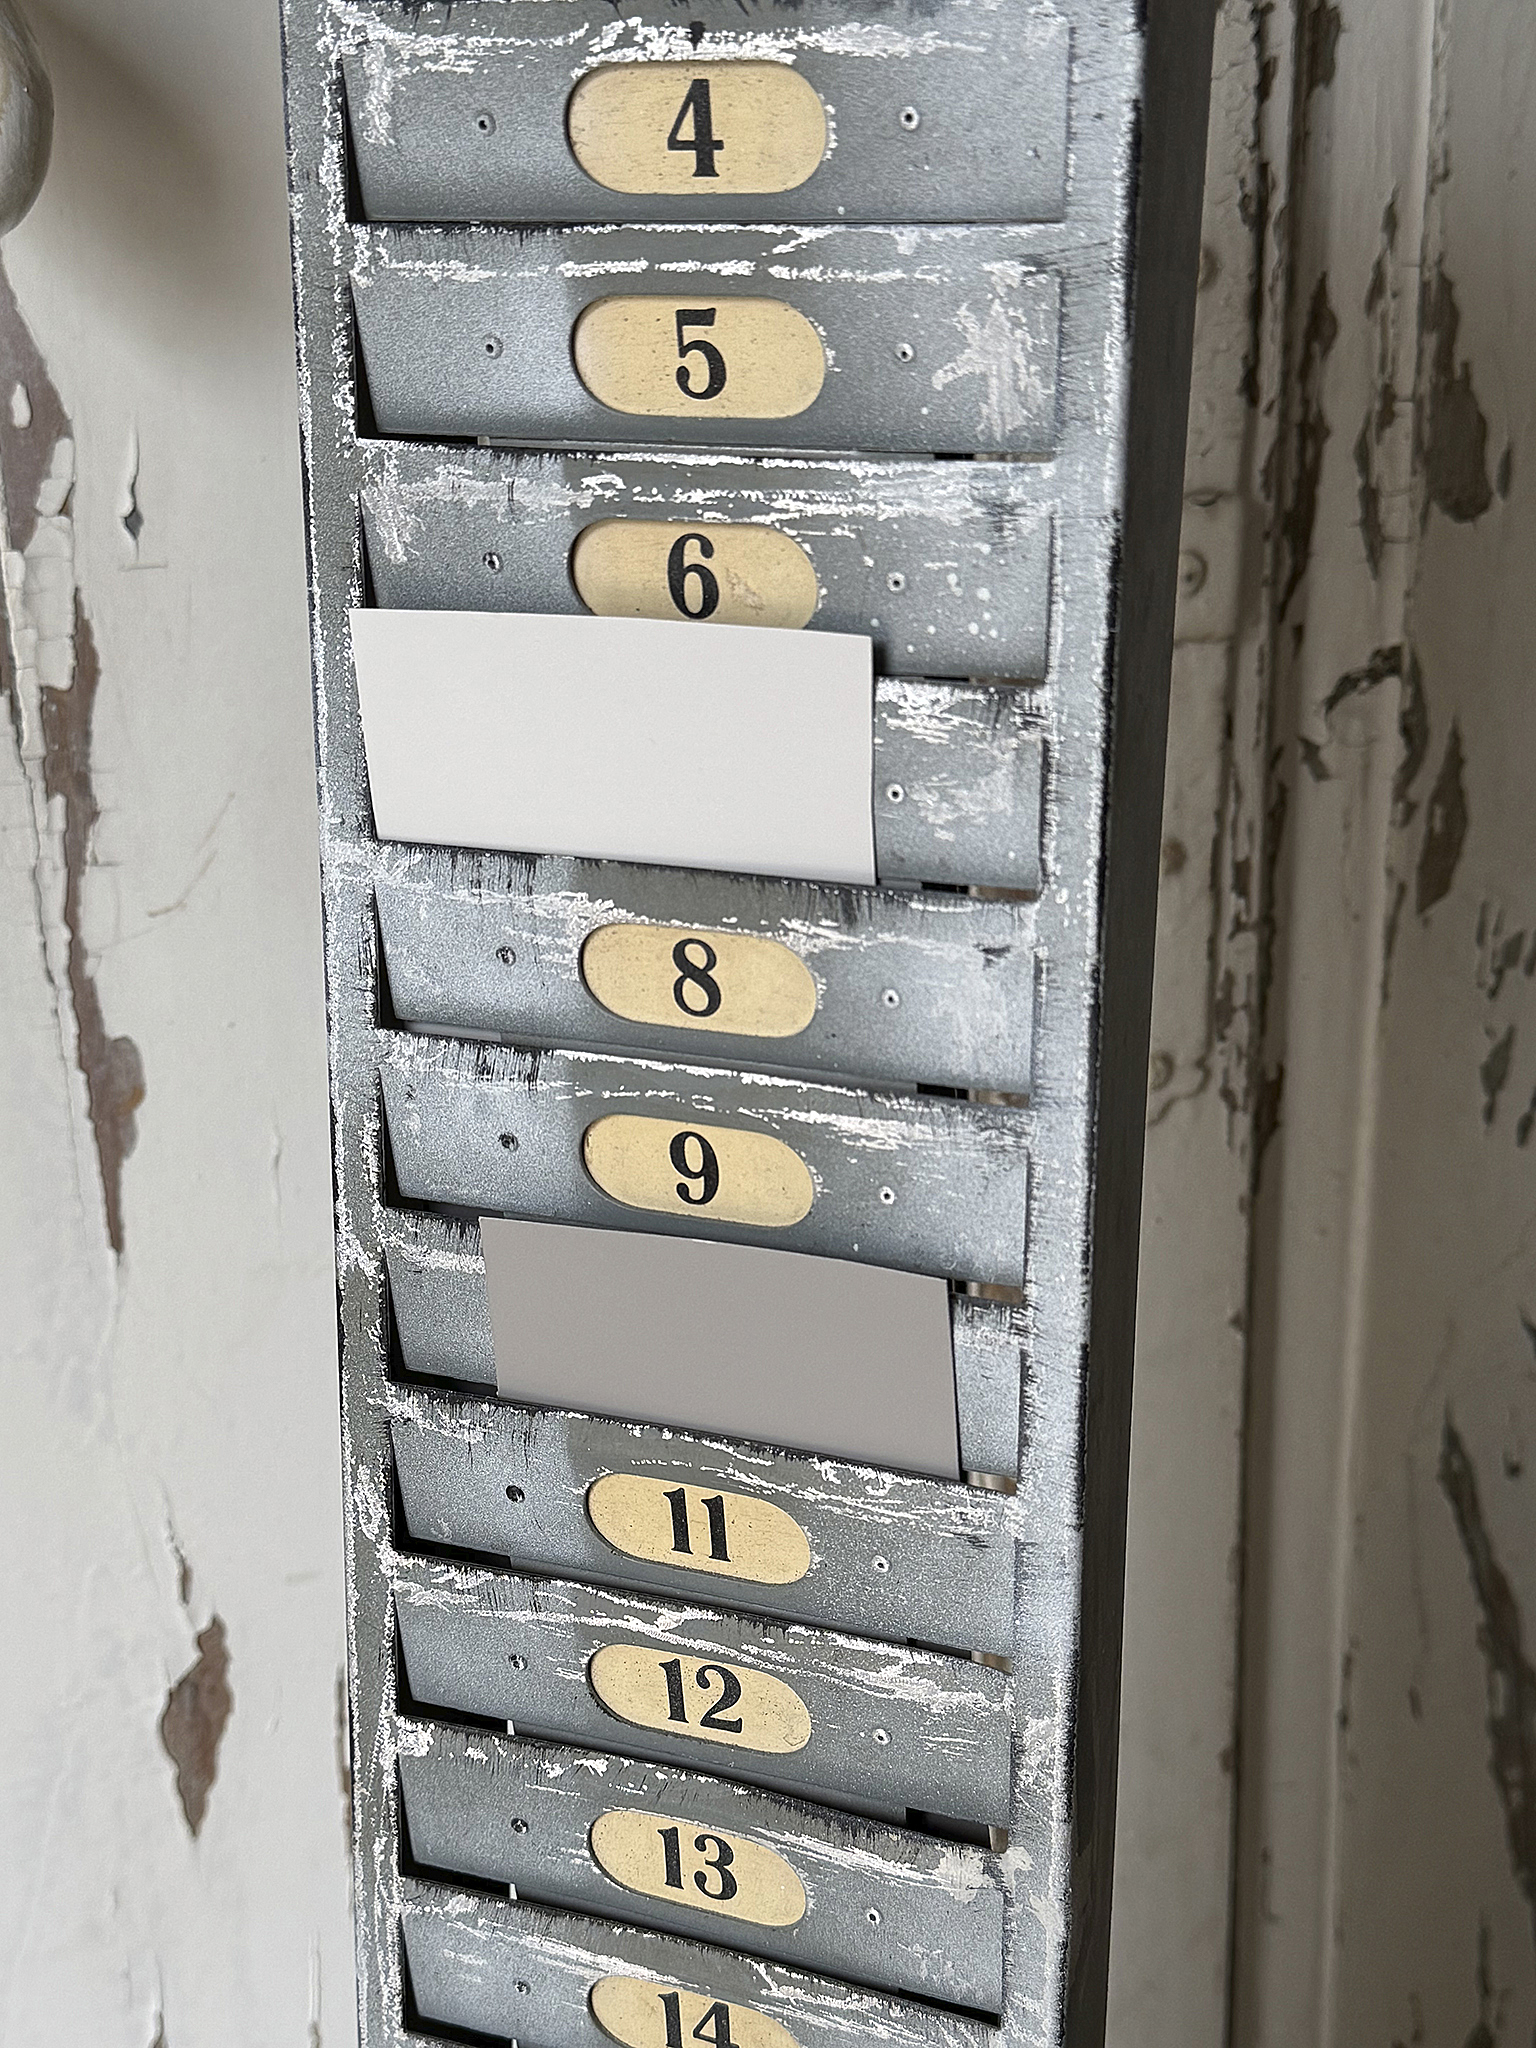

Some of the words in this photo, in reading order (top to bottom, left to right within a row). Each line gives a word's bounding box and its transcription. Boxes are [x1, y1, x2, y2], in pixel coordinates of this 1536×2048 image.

[667, 78, 725, 178] 4
[675, 307, 727, 400] 5
[667, 532, 720, 621] 6
[672, 937, 722, 1018] 8
[669, 1130, 720, 1206] 9
[662, 1487, 732, 1563] 11
[658, 1658, 744, 1734] 12
[657, 1826, 738, 1901] 13
[657, 1991, 740, 2048] 14
